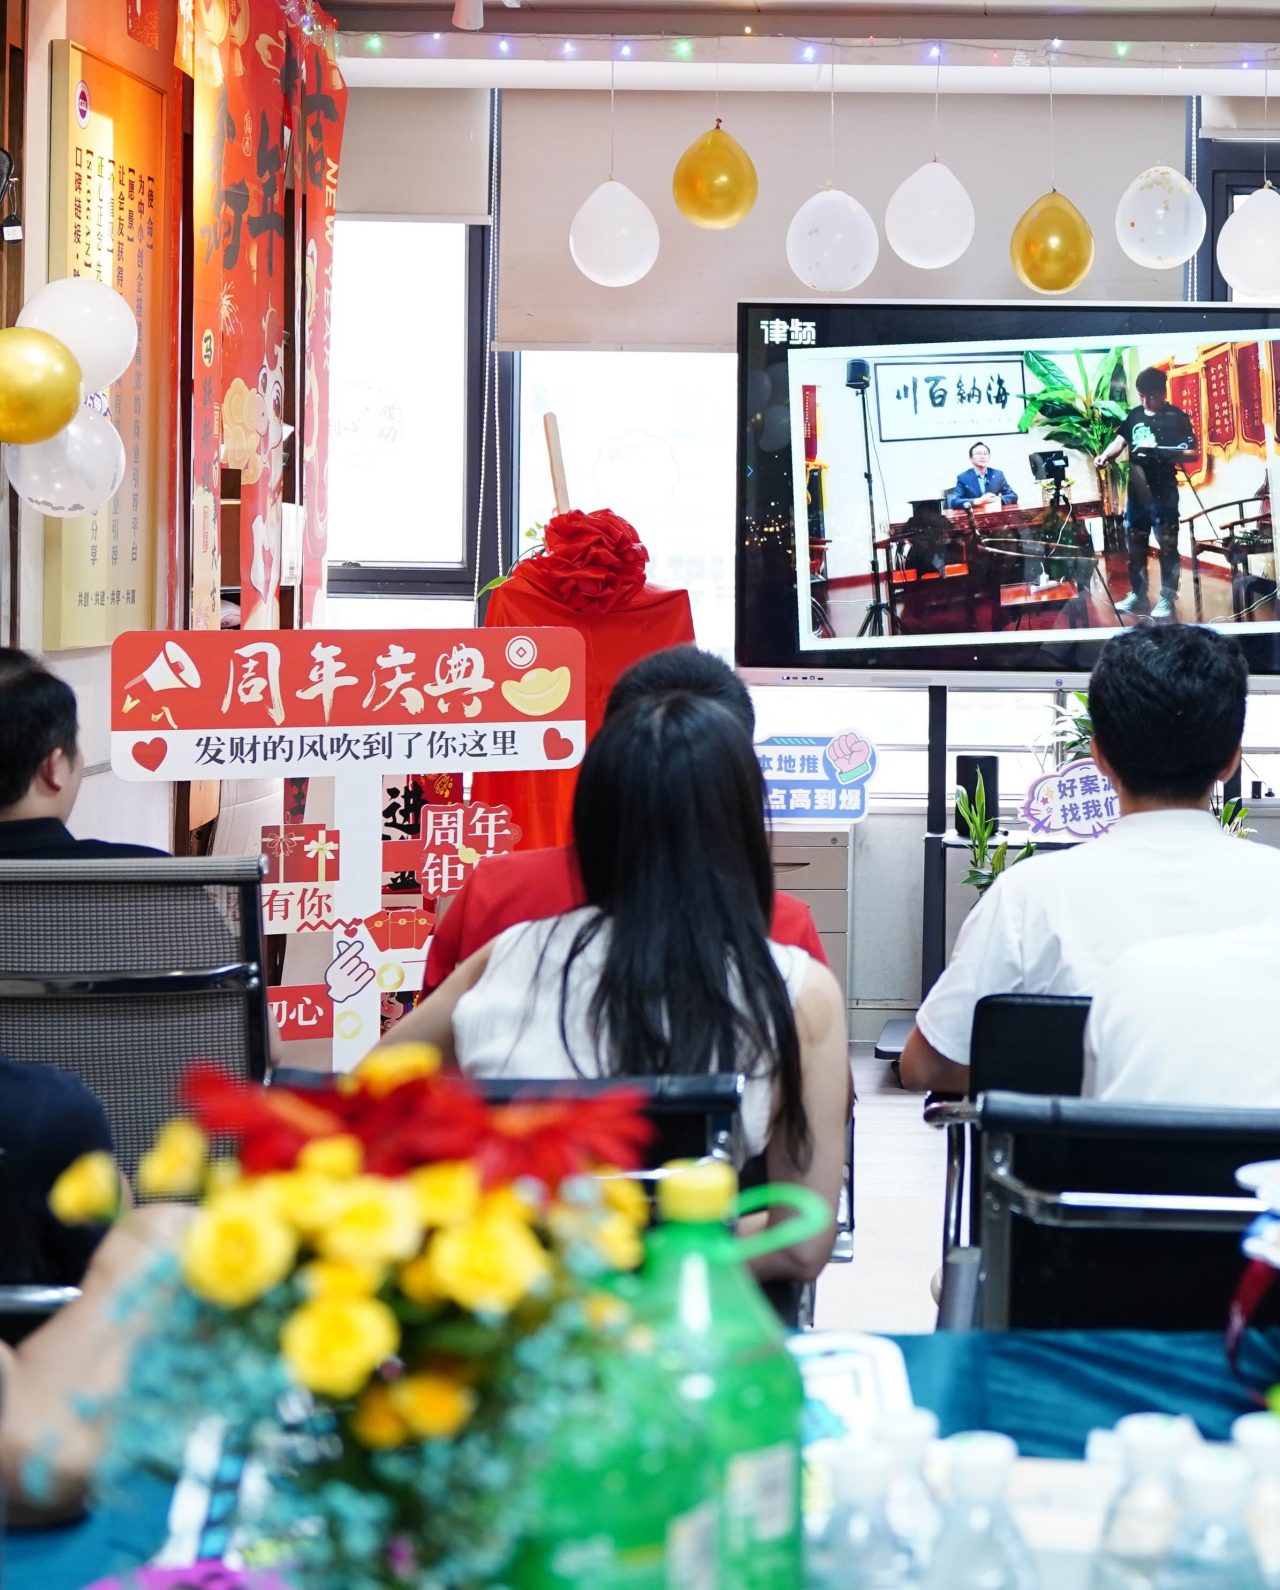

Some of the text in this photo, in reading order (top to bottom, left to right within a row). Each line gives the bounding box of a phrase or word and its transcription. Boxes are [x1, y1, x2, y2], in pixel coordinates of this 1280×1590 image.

[760, 319, 816, 345] 律频
[221, 641, 494, 727] 周年庆典
[195, 729, 519, 766] 发财的风吹到了你这里
[423, 807, 512, 851] 周年
